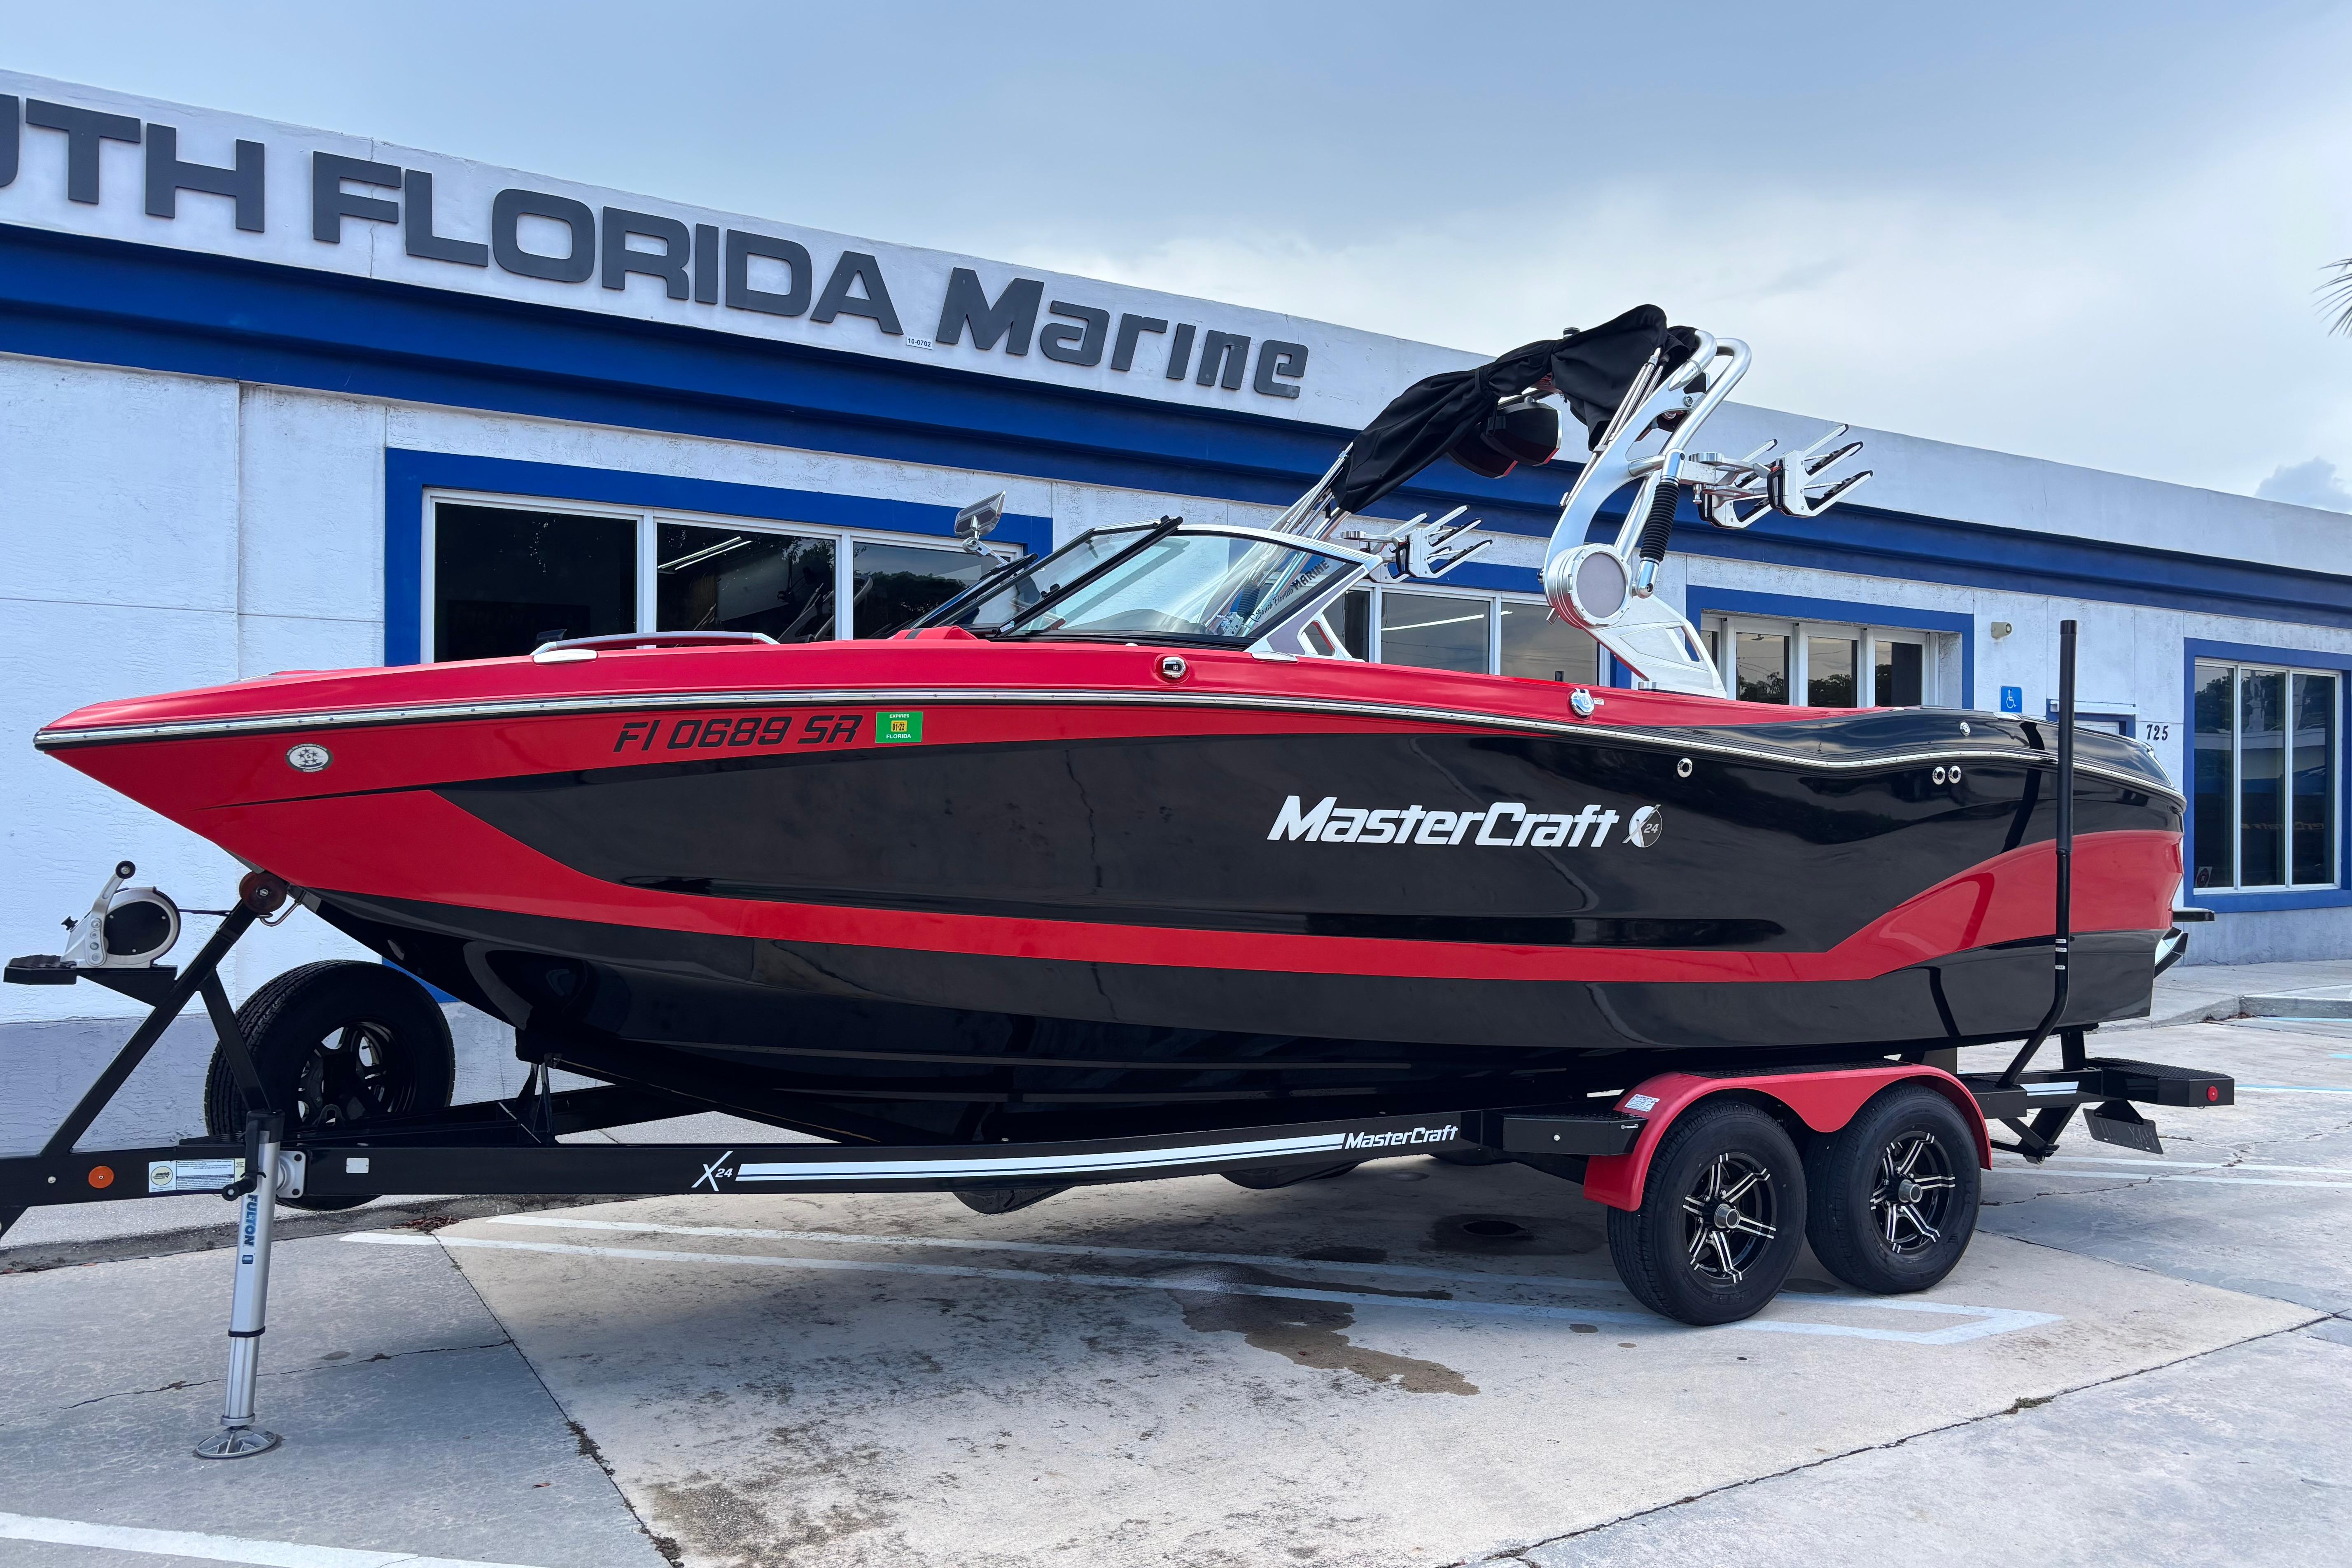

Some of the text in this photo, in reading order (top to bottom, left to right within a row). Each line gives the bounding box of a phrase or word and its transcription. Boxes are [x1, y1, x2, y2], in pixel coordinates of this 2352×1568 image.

[0, 94, 1309, 399] TH FLORIDA Marine
[908, 338, 931, 347] 10-0702
[1290, 560, 1330, 590] MARINE
[667, 716, 793, 750] 0689
[797, 715, 863, 744] SR
[2146, 724, 2169, 741] 725
[1267, 795, 1620, 848] MasterCraft
[1345, 1125, 1458, 1149] MasterCraft
[691, 1150, 733, 1191] X24
[244, 1194, 259, 1246] FULTON
